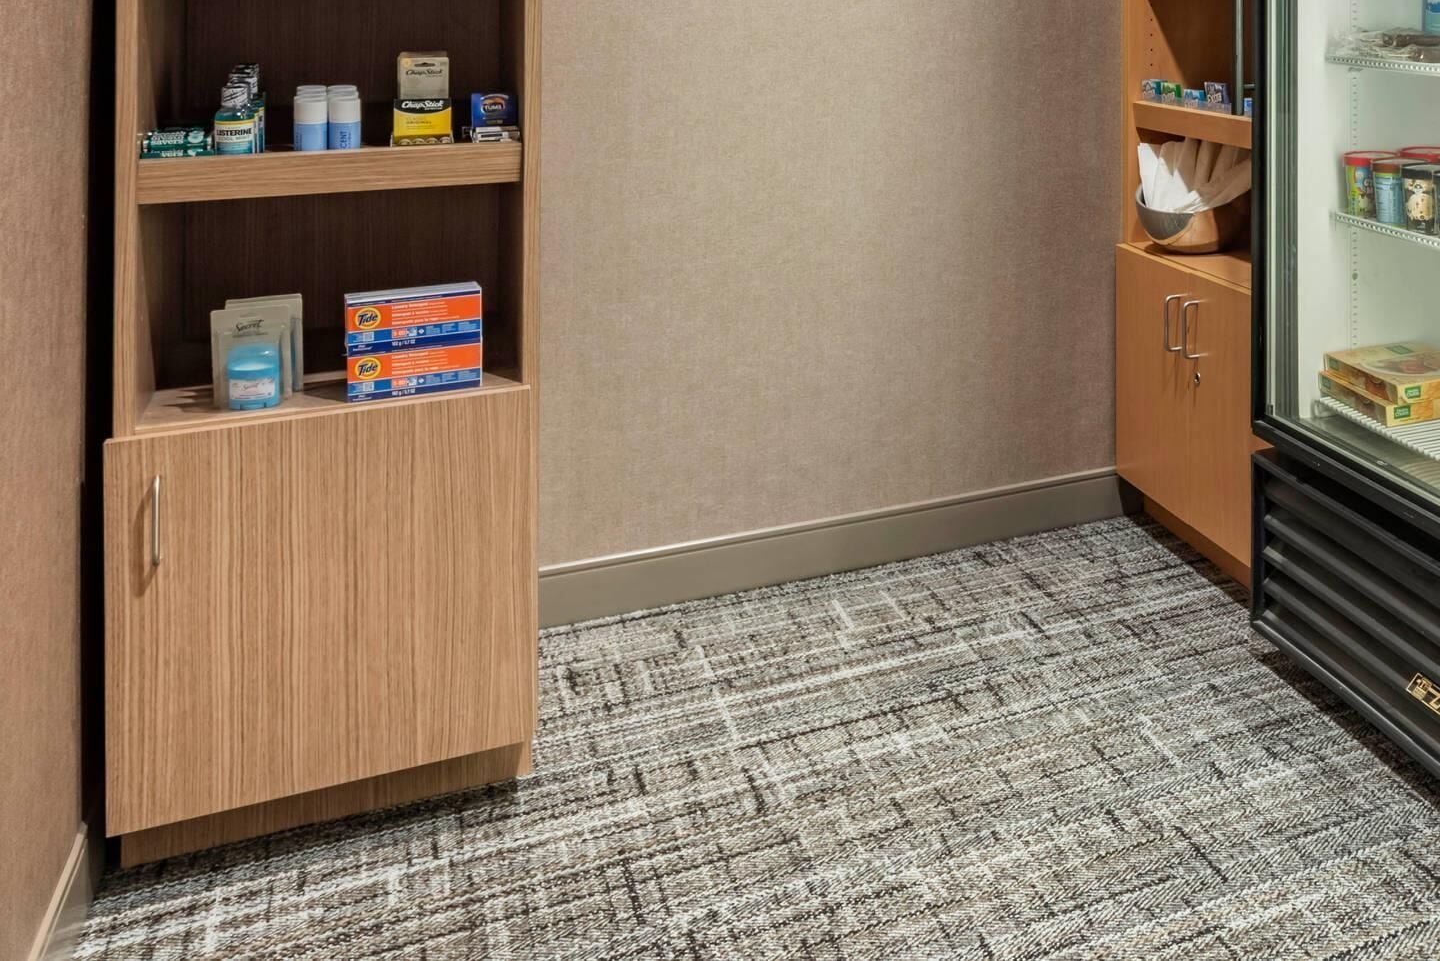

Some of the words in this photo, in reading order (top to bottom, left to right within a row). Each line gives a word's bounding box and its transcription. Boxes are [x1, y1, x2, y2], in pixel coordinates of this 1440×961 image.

[401, 99, 445, 110] ChapStick
[216, 127, 253, 137] LISTERINE
[357, 312, 379, 326] Tide
[357, 363, 379, 377] Tide
